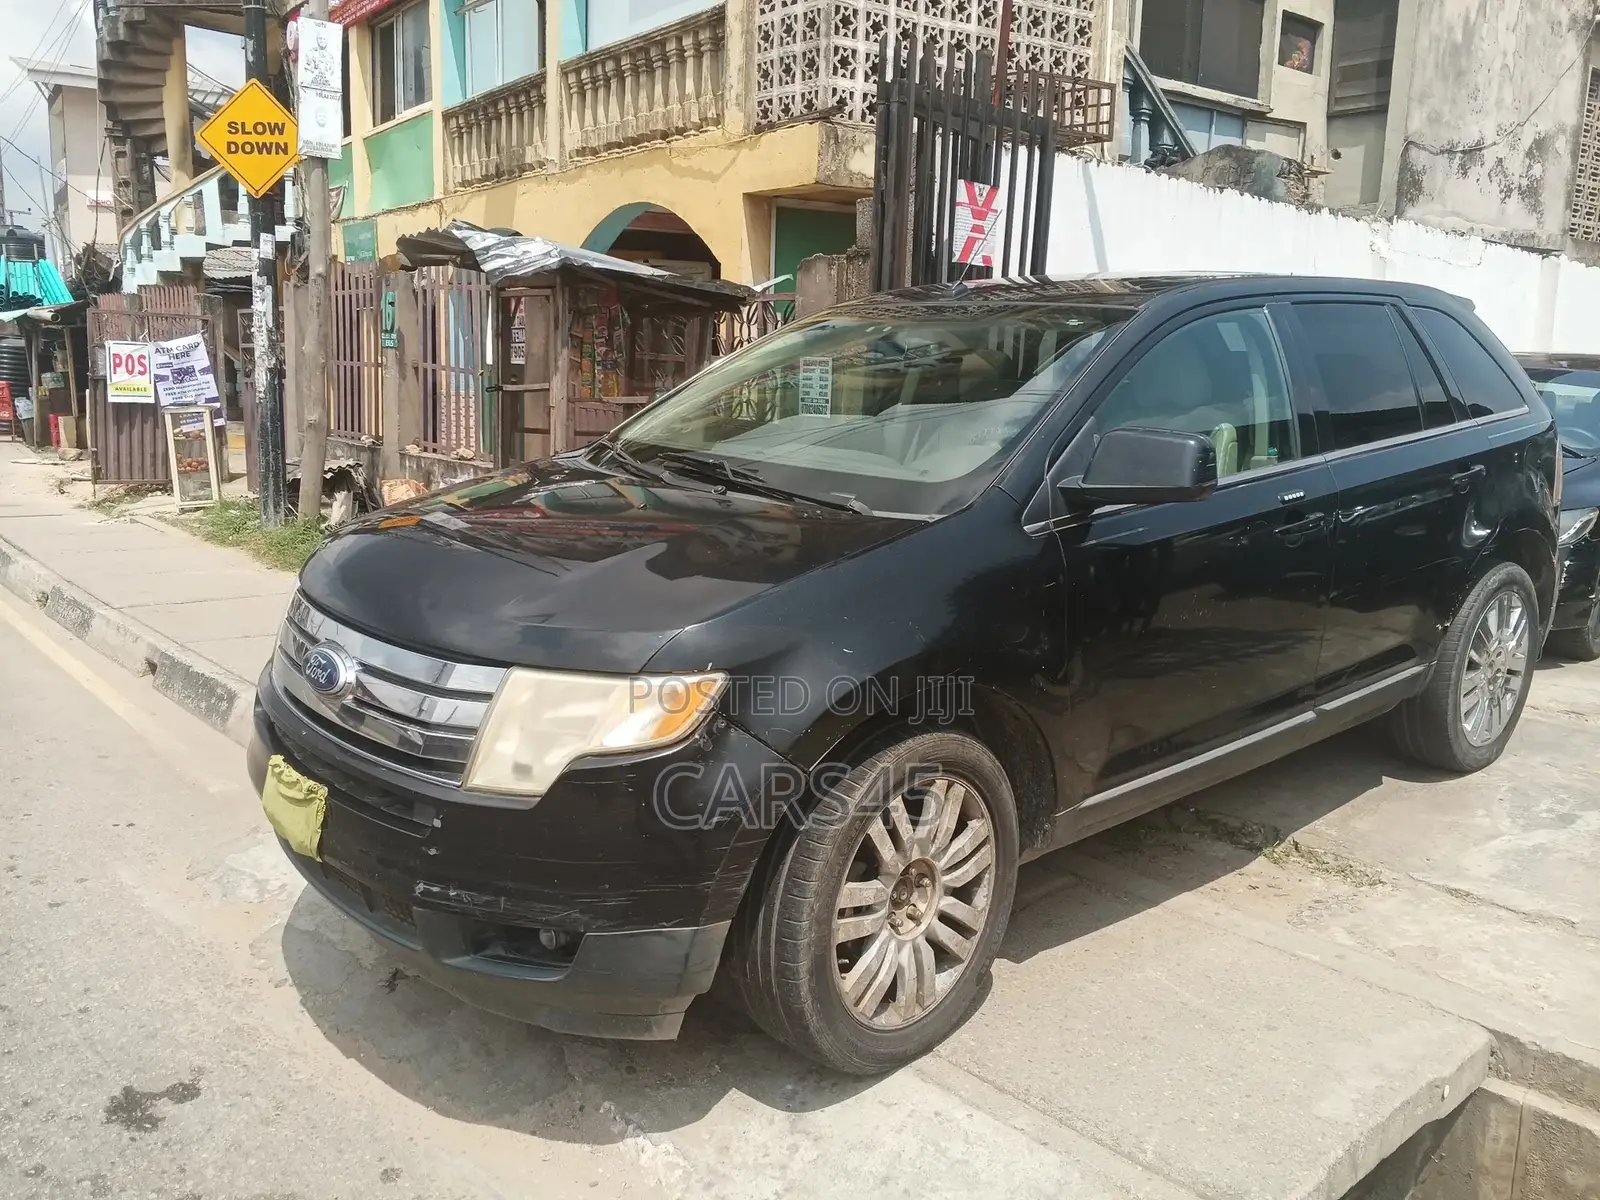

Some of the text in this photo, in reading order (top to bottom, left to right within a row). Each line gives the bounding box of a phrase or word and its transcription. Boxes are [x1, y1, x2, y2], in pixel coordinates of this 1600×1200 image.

[227, 121, 286, 136] SLOW
[226, 141, 289, 155] DOWN
[154, 341, 200, 355] ATM CARD
[168, 351, 191, 361] HERE
[112, 353, 148, 376] POS
[306, 654, 331, 684] Ford
